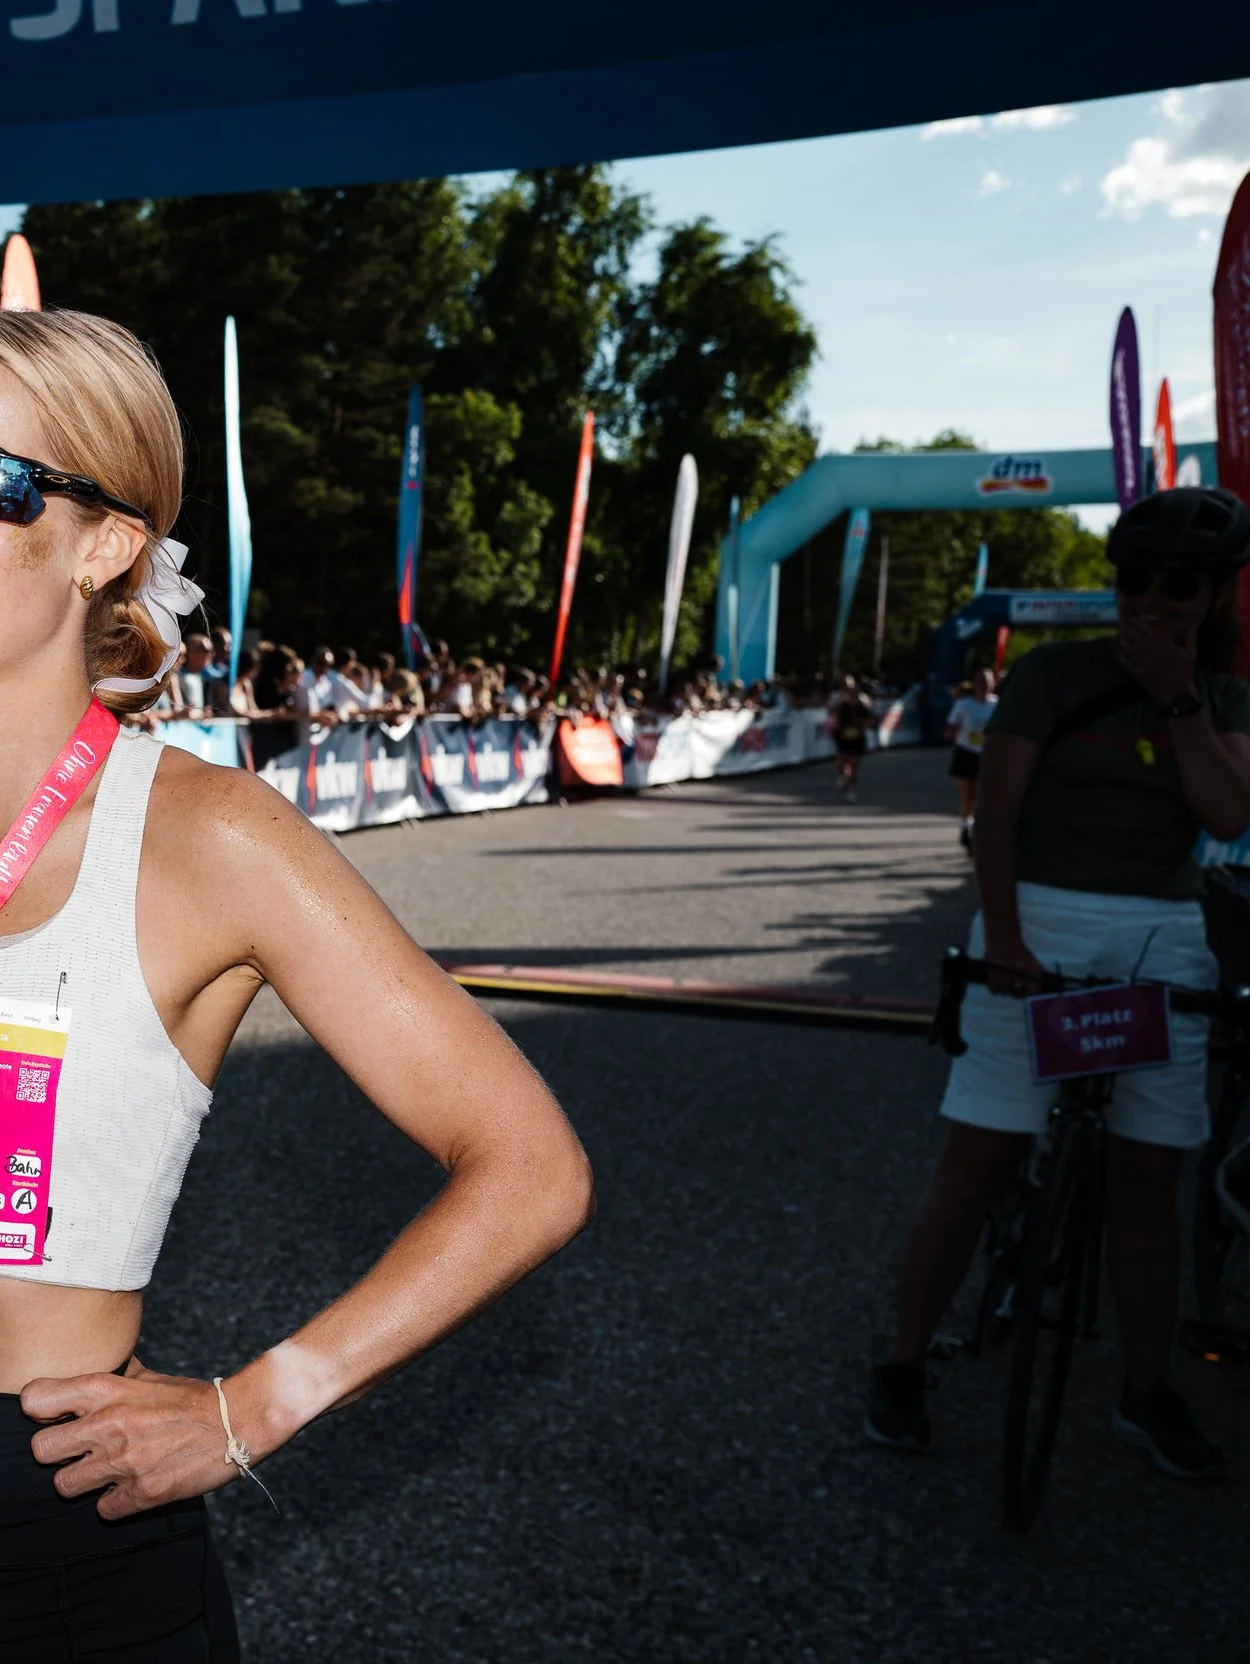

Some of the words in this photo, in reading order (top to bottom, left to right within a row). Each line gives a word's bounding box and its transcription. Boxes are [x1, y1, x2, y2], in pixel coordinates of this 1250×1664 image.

[993, 455, 1042, 479] dm
[56, 741, 96, 784] Ohne
[15, 786, 67, 841] Frauen
[4, 1155, 43, 1176] Bahn
[15, 1190, 32, 1210] A
